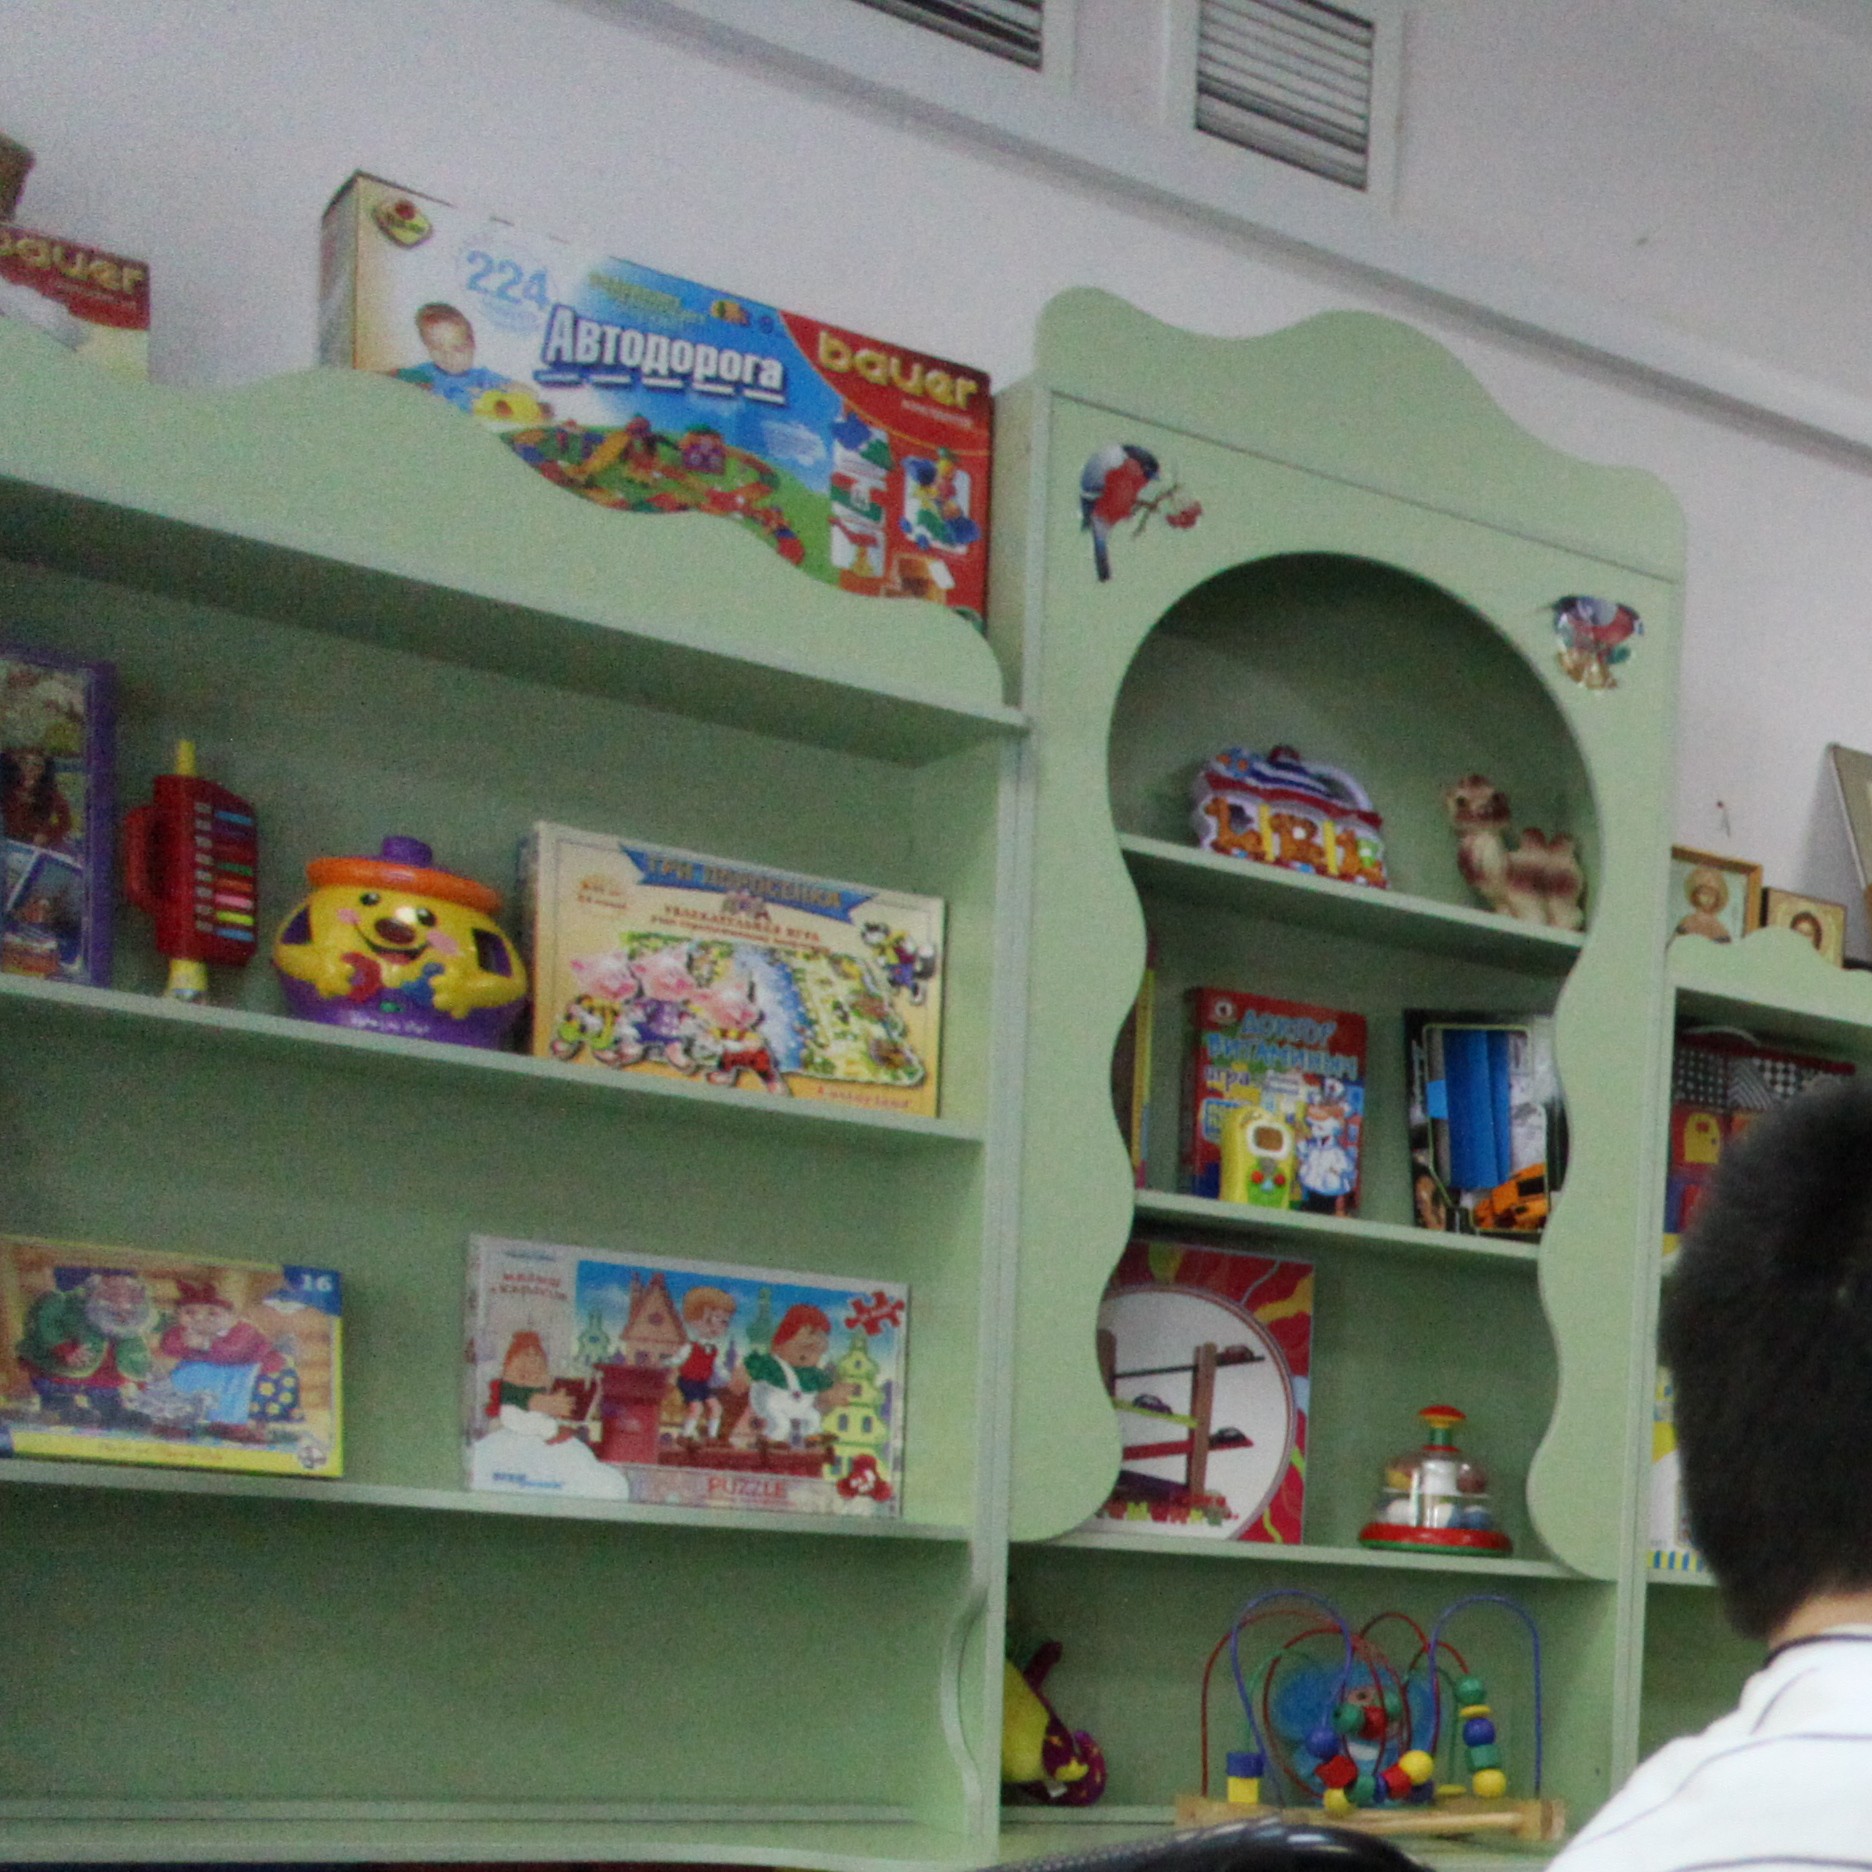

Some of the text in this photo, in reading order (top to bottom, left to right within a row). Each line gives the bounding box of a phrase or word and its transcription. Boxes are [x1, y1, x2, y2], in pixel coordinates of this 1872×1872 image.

[466, 250, 548, 310] 224
[817, 330, 978, 410] bauer
[301, 1272, 333, 1292] 16
[707, 1475, 786, 1500] PUZZLE
